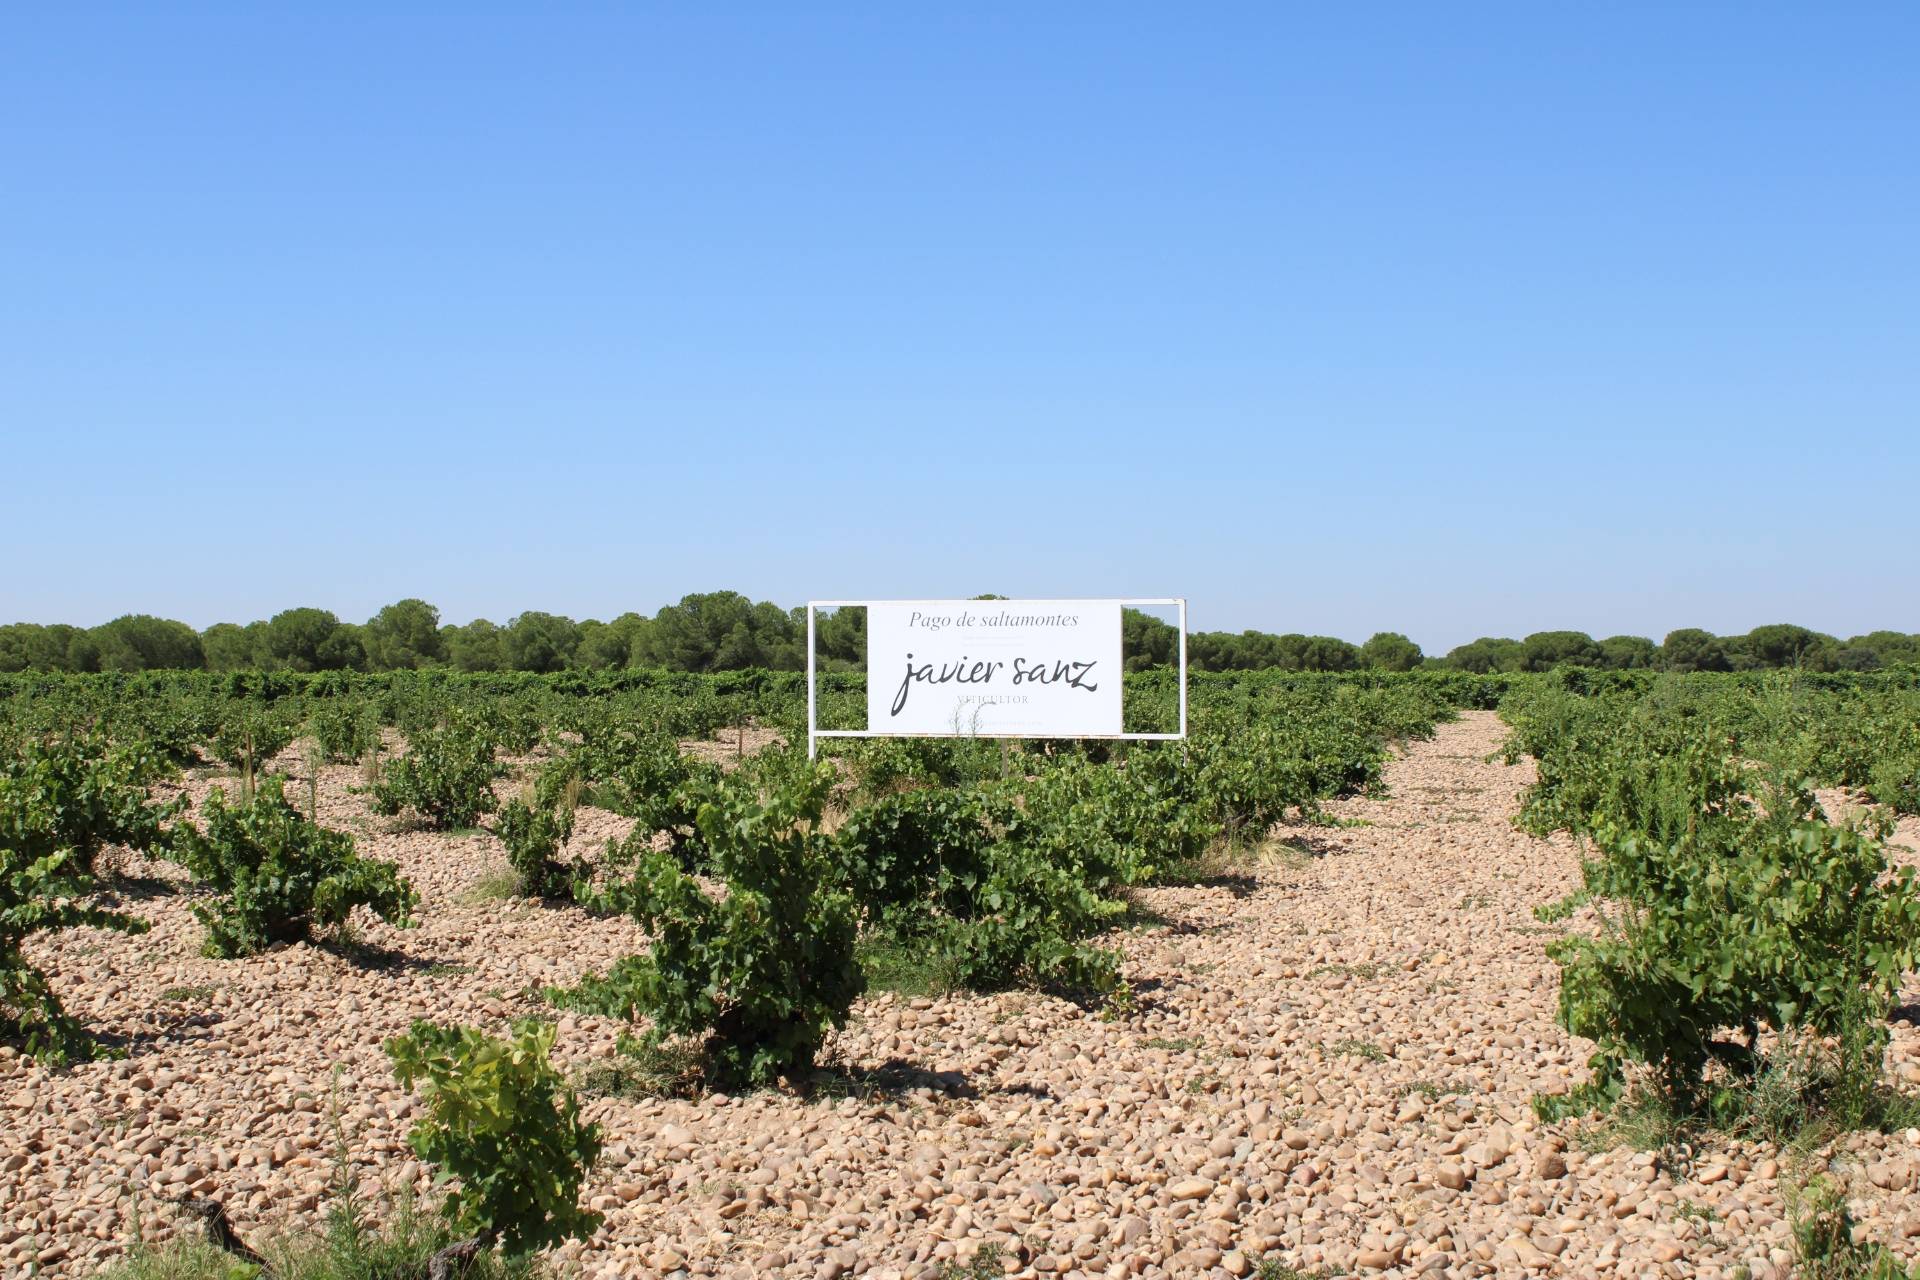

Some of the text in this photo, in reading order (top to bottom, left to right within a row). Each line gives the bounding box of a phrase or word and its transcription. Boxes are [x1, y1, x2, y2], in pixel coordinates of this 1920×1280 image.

[909, 611, 1079, 631] Pago de saltamontes
[890, 653, 1098, 717] javier sanz
